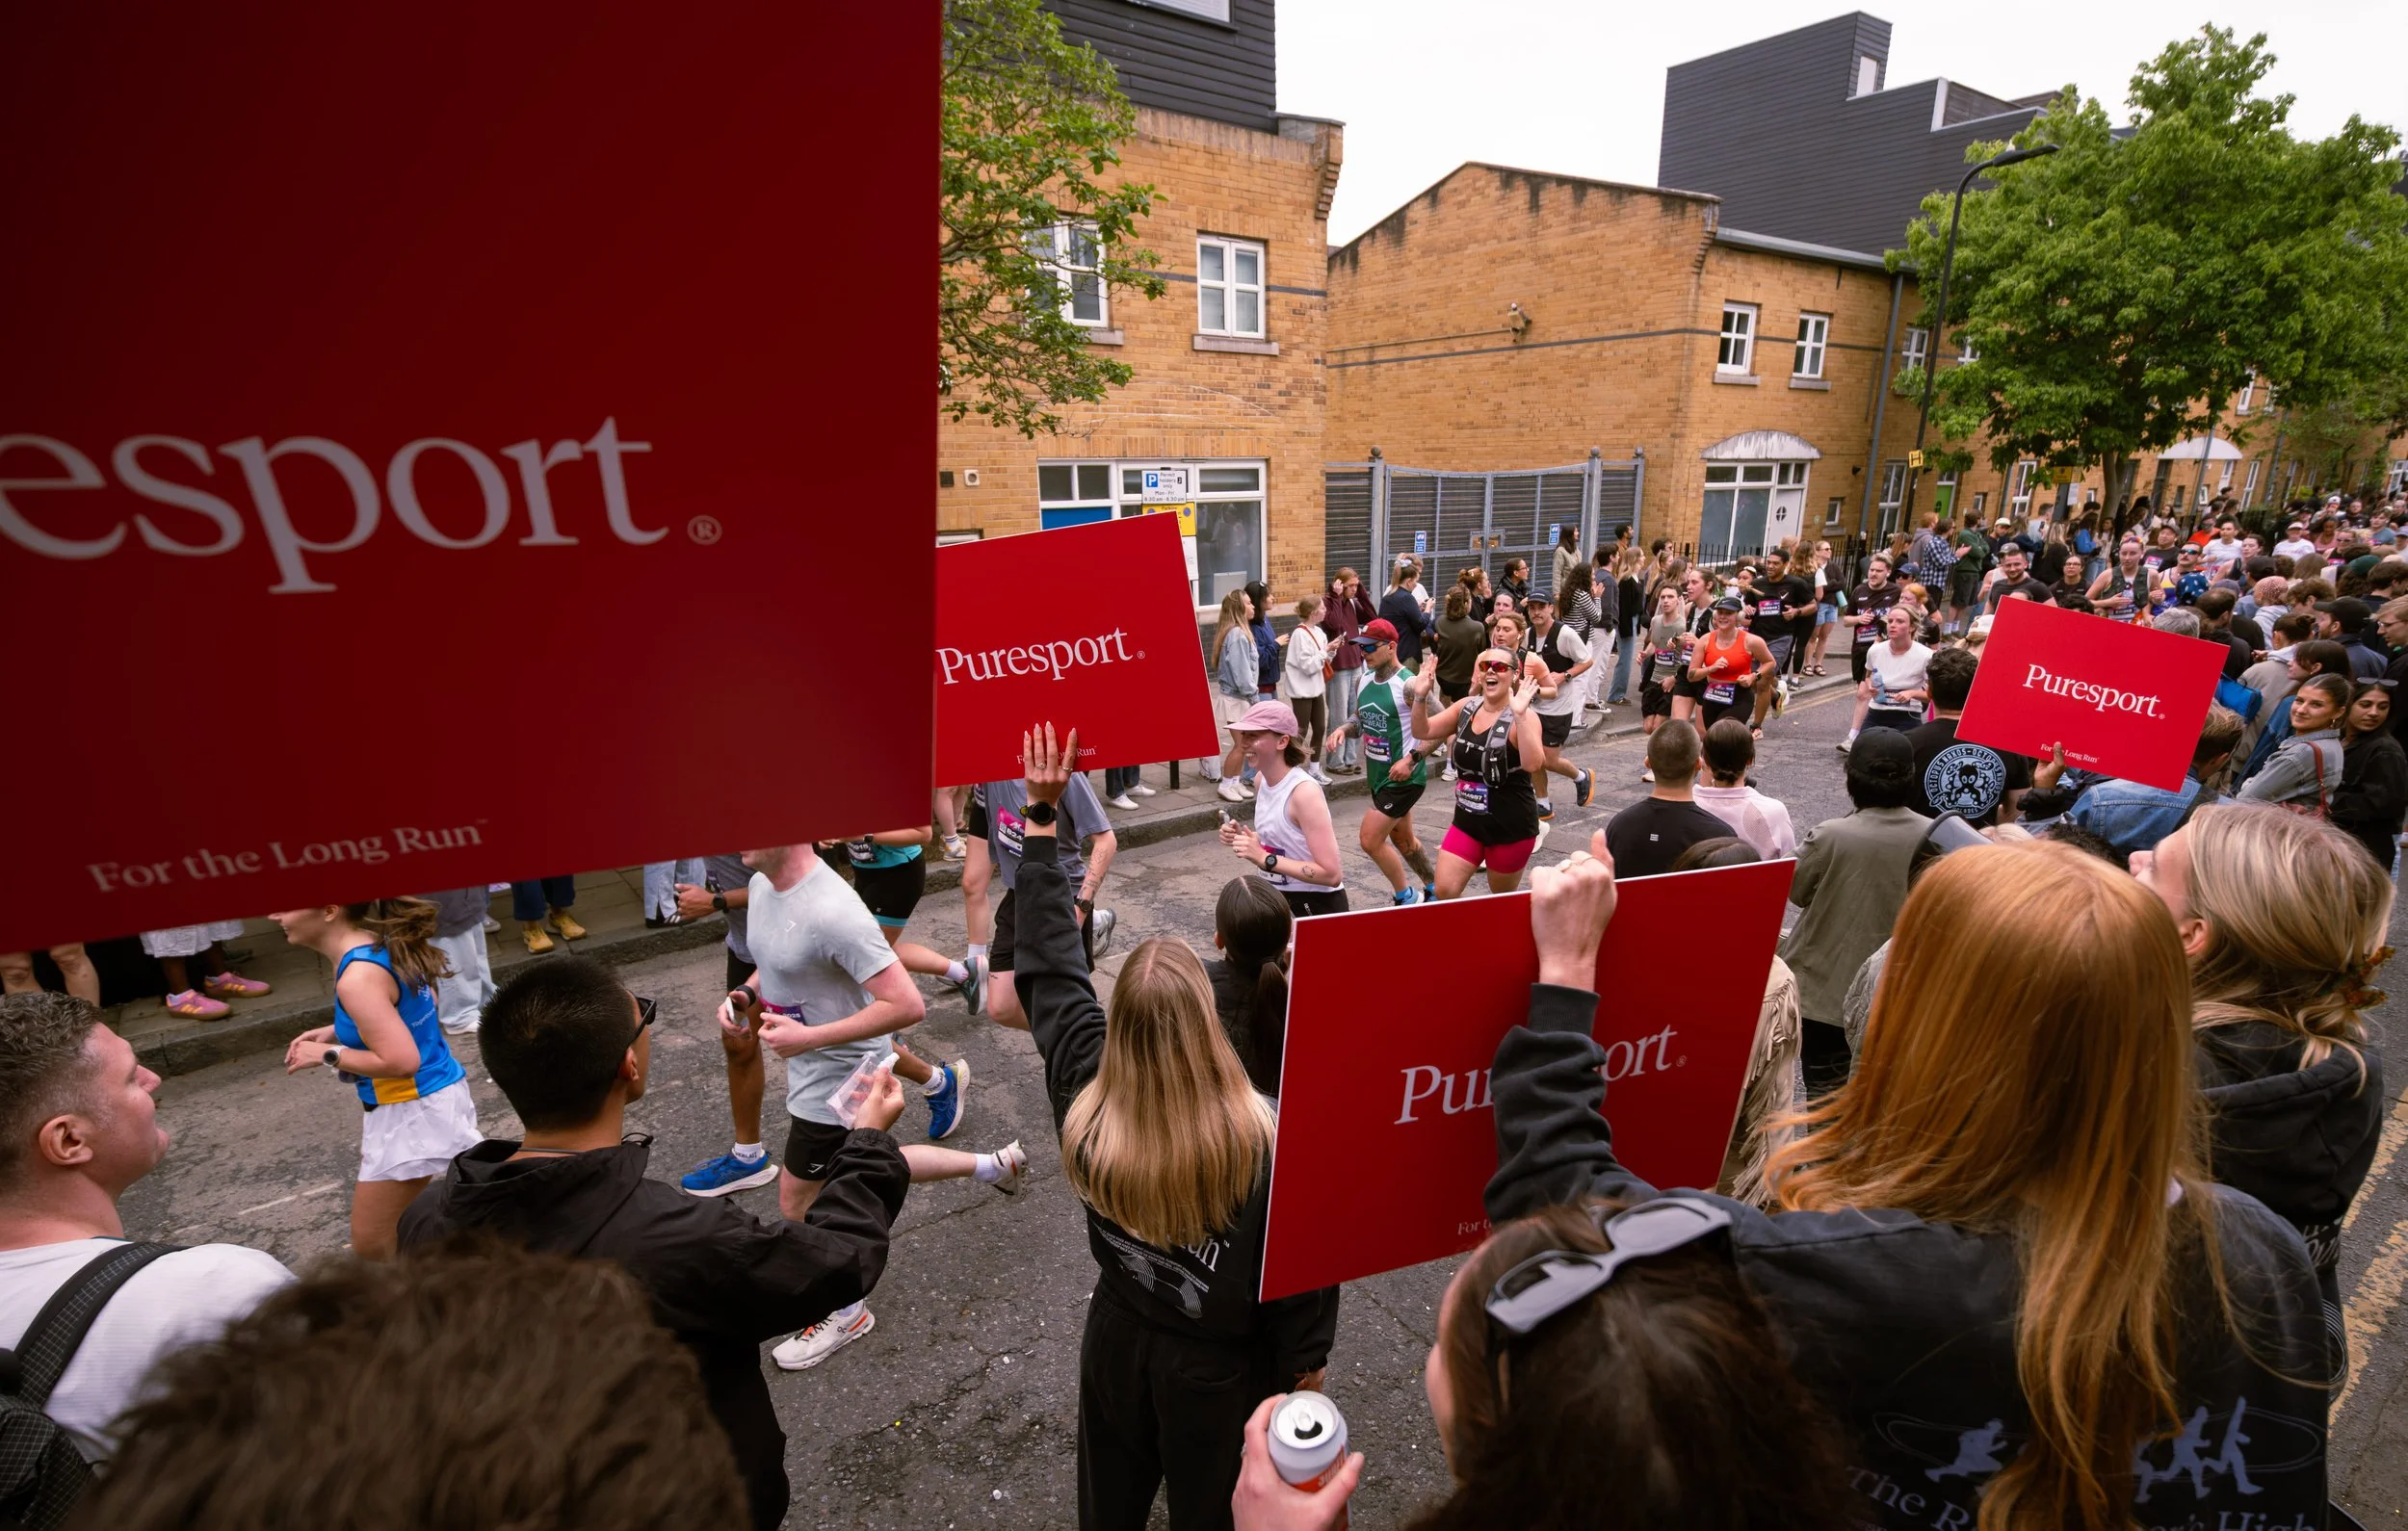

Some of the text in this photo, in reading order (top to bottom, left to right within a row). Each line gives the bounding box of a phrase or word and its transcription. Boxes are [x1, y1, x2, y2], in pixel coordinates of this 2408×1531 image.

[1929, 761, 1945, 792] OCTOPUS
[1942, 748, 1967, 764] NAXOS
[2040, 743, 2053, 752] For
[2064, 749, 2082, 761] Long
[86, 861, 172, 894] For
[182, 848, 263, 880] the
[269, 835, 390, 866] Long
[1394, 1025, 1678, 1125] Purort
[1457, 1220, 1480, 1235] For
[1845, 1466, 1926, 1516] The
